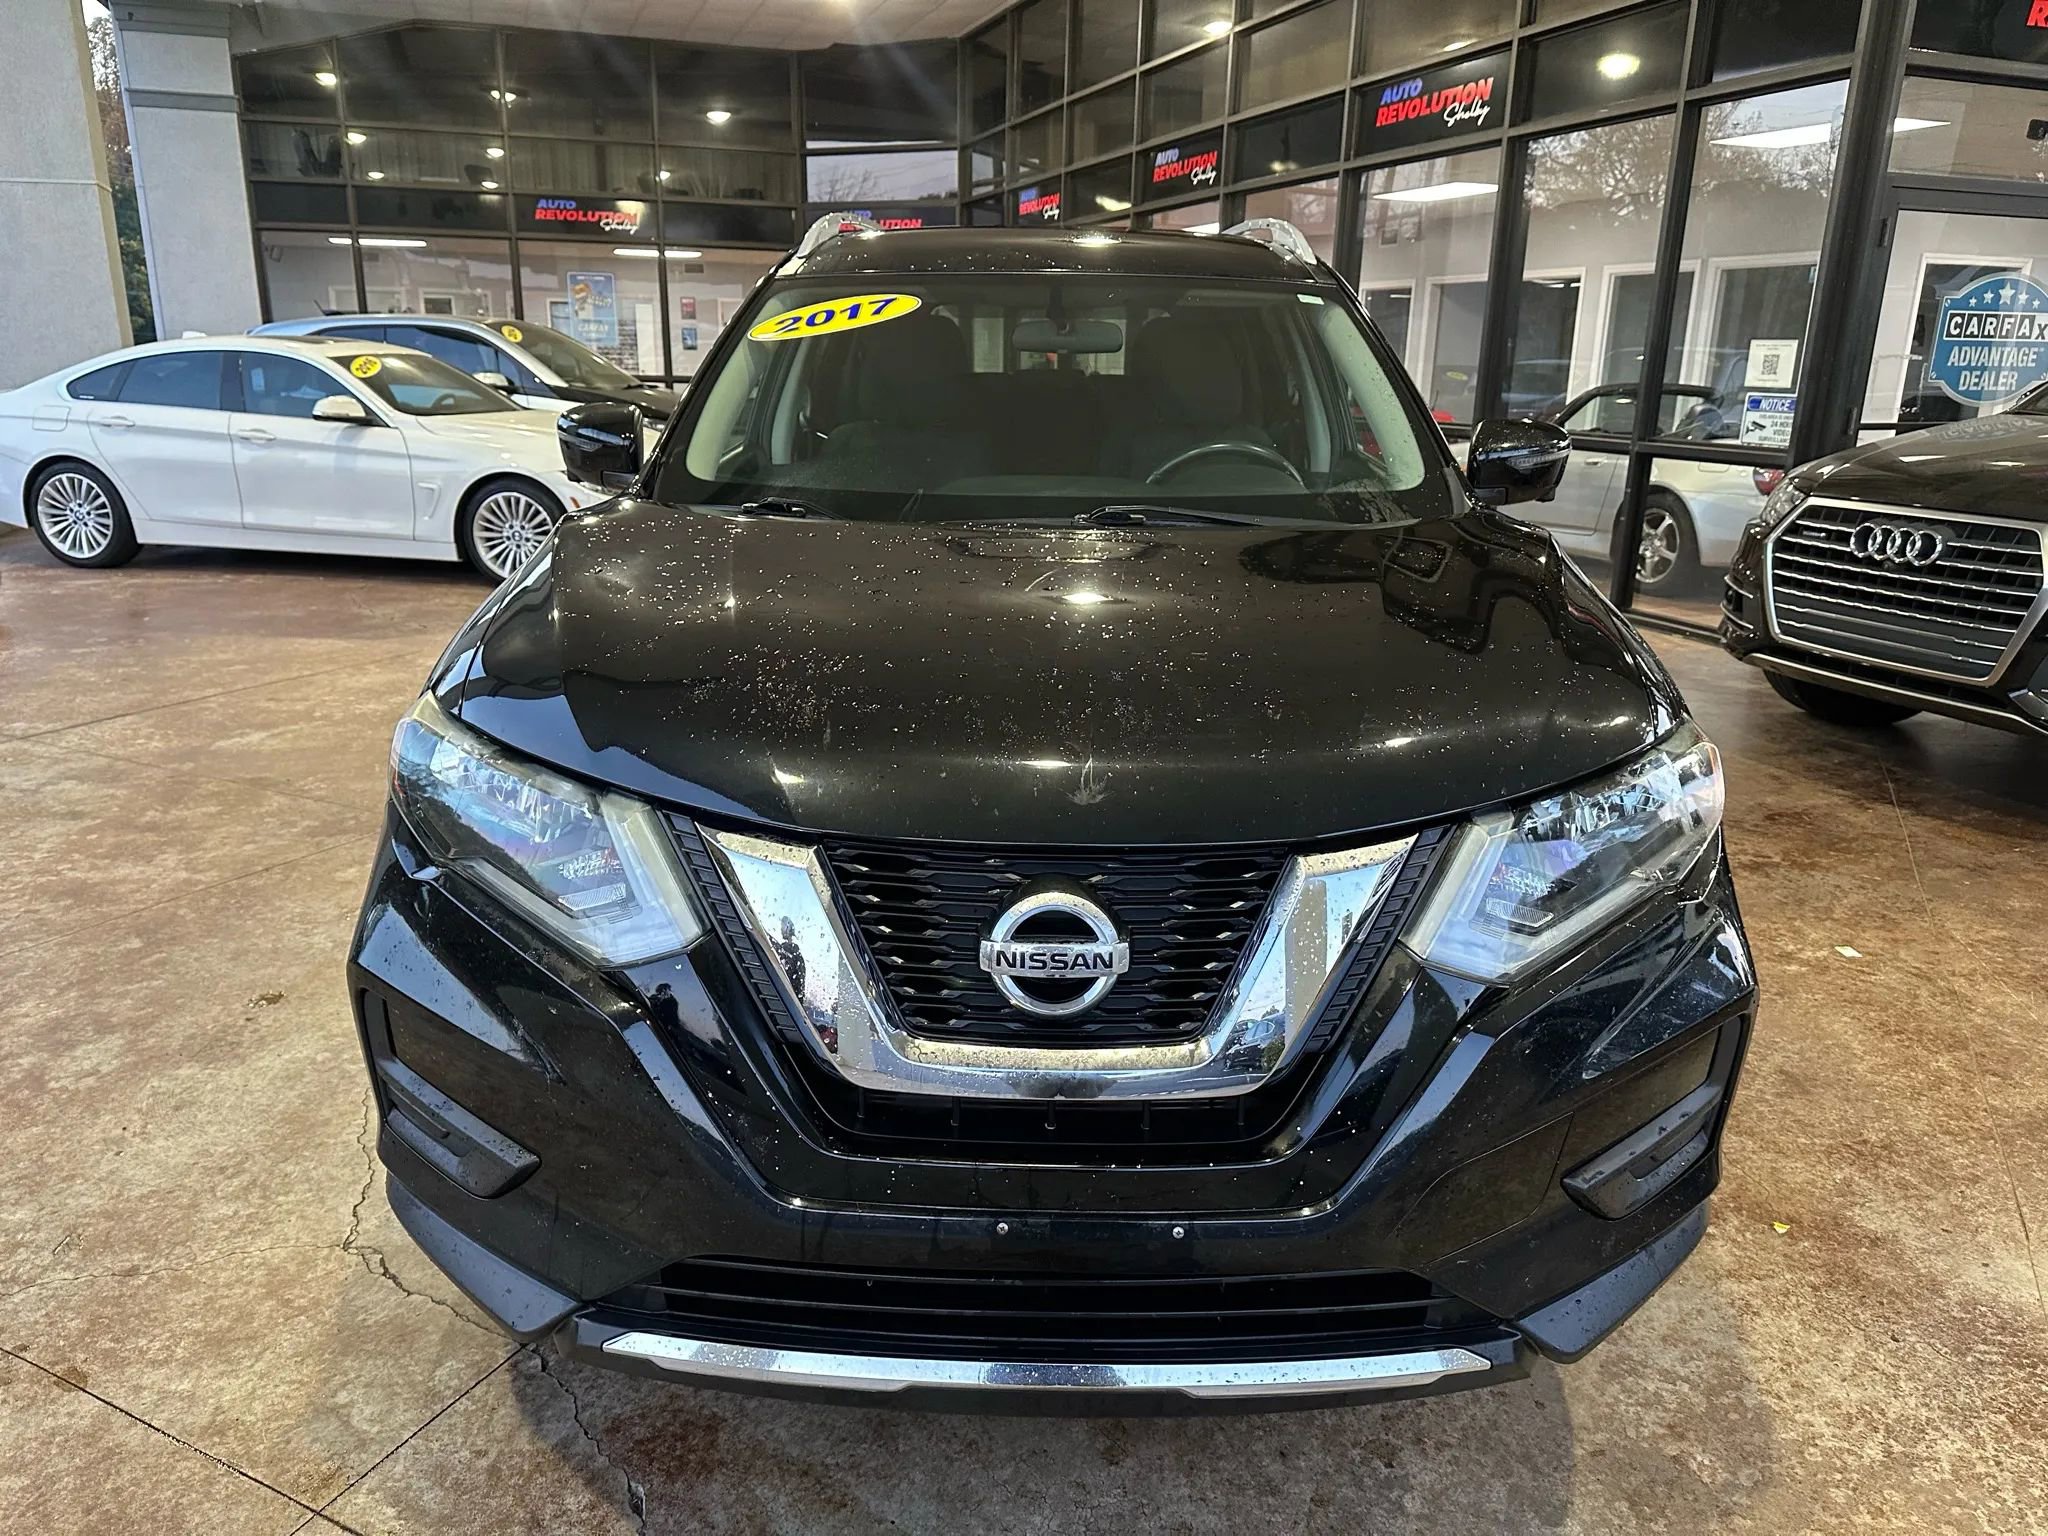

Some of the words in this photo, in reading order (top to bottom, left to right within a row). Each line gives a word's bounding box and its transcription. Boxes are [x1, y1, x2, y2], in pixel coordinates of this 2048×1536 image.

[1376, 77, 1494, 127] REVOLUTION
[1380, 78, 1423, 105] AUTO
[1443, 95, 1491, 127] Shelby
[1152, 150, 1218, 183] REVOLUTION
[1155, 147, 1180, 167] AUTO
[537, 199, 577, 210] AUTO
[534, 208, 641, 226] REVOLUTION
[774, 297, 898, 333] 2017
[1949, 314, 2048, 341] CARFAX
[1947, 346, 2038, 367] ADVANTAGE
[1958, 370, 2018, 391] DEALER
[1759, 398, 1792, 411] NOTICE
[995, 950, 1114, 971] NISSAN
